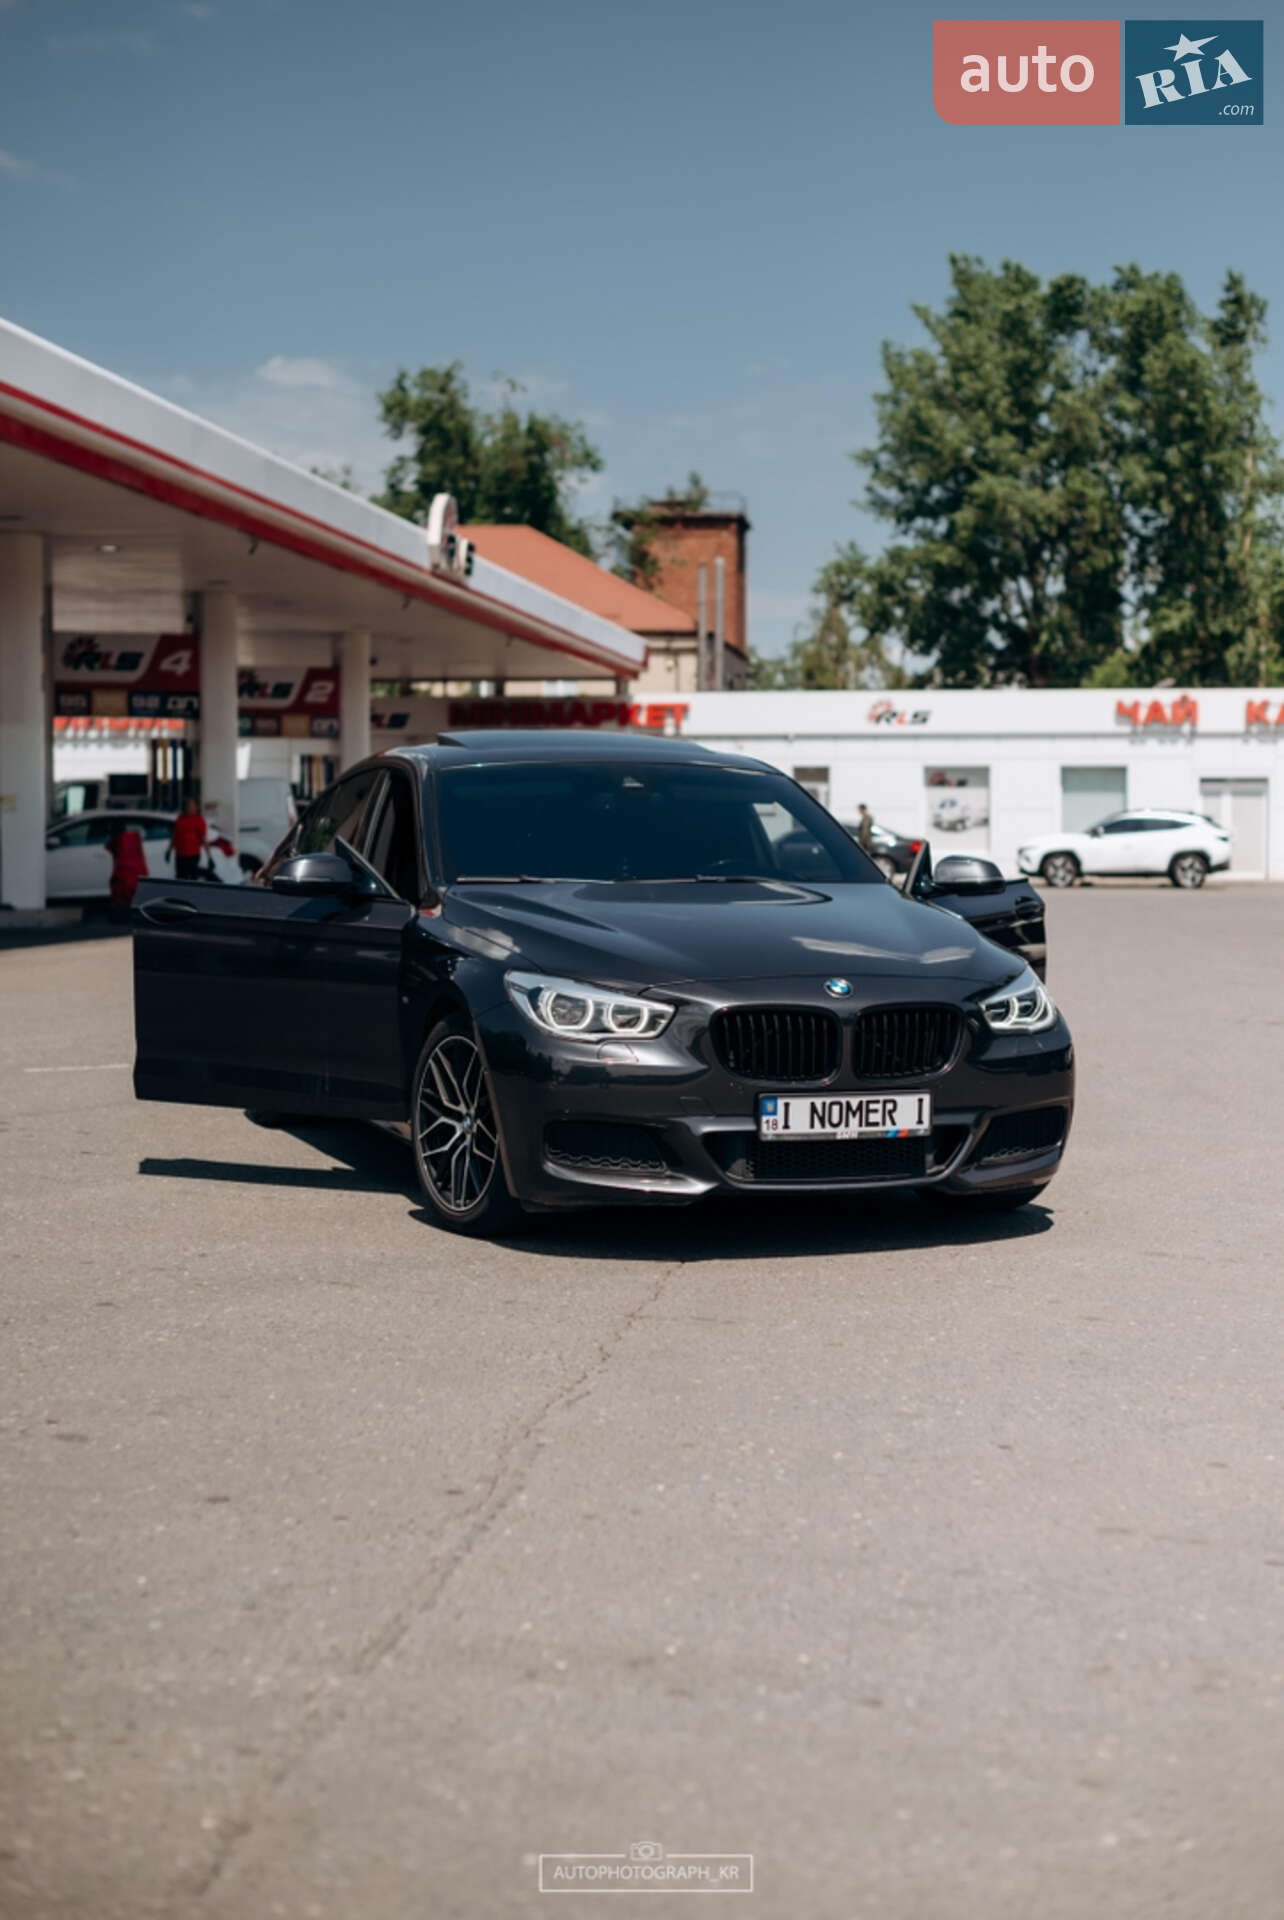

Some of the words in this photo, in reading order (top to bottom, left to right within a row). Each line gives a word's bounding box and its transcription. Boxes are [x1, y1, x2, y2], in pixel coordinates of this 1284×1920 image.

[159, 650, 193, 676] 4
[303, 680, 335, 702] 2
[1116, 693, 1198, 725] ЧАЙ
[810, 1099, 897, 1129] NOMER
